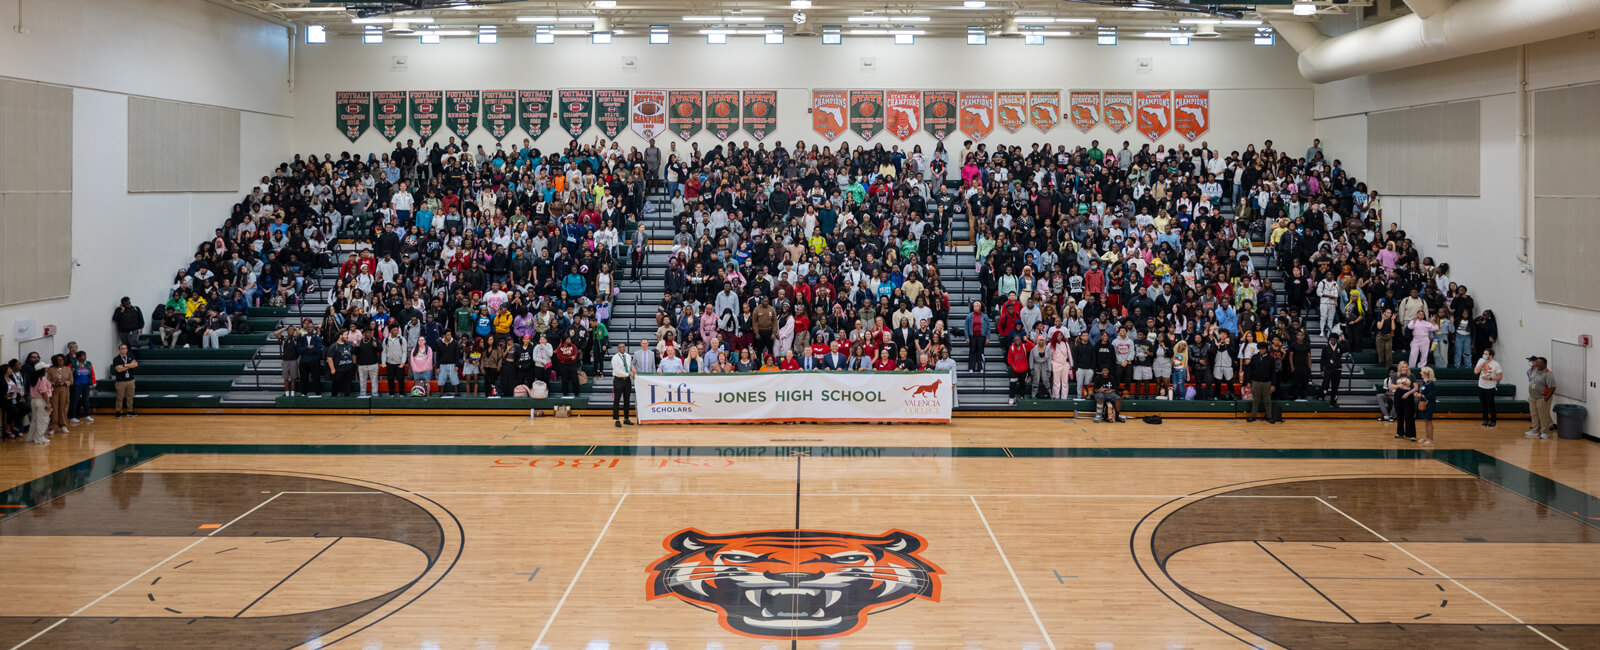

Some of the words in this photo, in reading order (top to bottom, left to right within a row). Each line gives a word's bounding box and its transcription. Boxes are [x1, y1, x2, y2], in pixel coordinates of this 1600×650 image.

[634, 95, 664, 106] DISTRICT
[670, 95, 701, 107] STATE
[707, 95, 738, 106] STATE
[744, 95, 775, 106] STATE
[815, 98, 846, 108] CHAMPIONS
[852, 95, 882, 106] STATE
[887, 98, 920, 108] CHAMPIONS
[925, 96, 955, 107] STATE
[961, 99, 992, 109] CHAMPIONS
[999, 98, 1025, 106] RUNNER-UP
[1031, 98, 1058, 107] CHAMPIONS
[1072, 98, 1099, 106] RUNNER-UP
[1105, 98, 1132, 107] CHAMPIONS
[1138, 98, 1170, 109] CHAMPIONS
[1176, 98, 1207, 109] CHAMPIONS
[633, 113, 664, 124] CHAMPIONS
[648, 382, 696, 404] Lift
[715, 391, 767, 403] JONES
[775, 390, 812, 402] HIGH
[821, 390, 886, 402] SCHOOL
[490, 457, 619, 468] 1895
